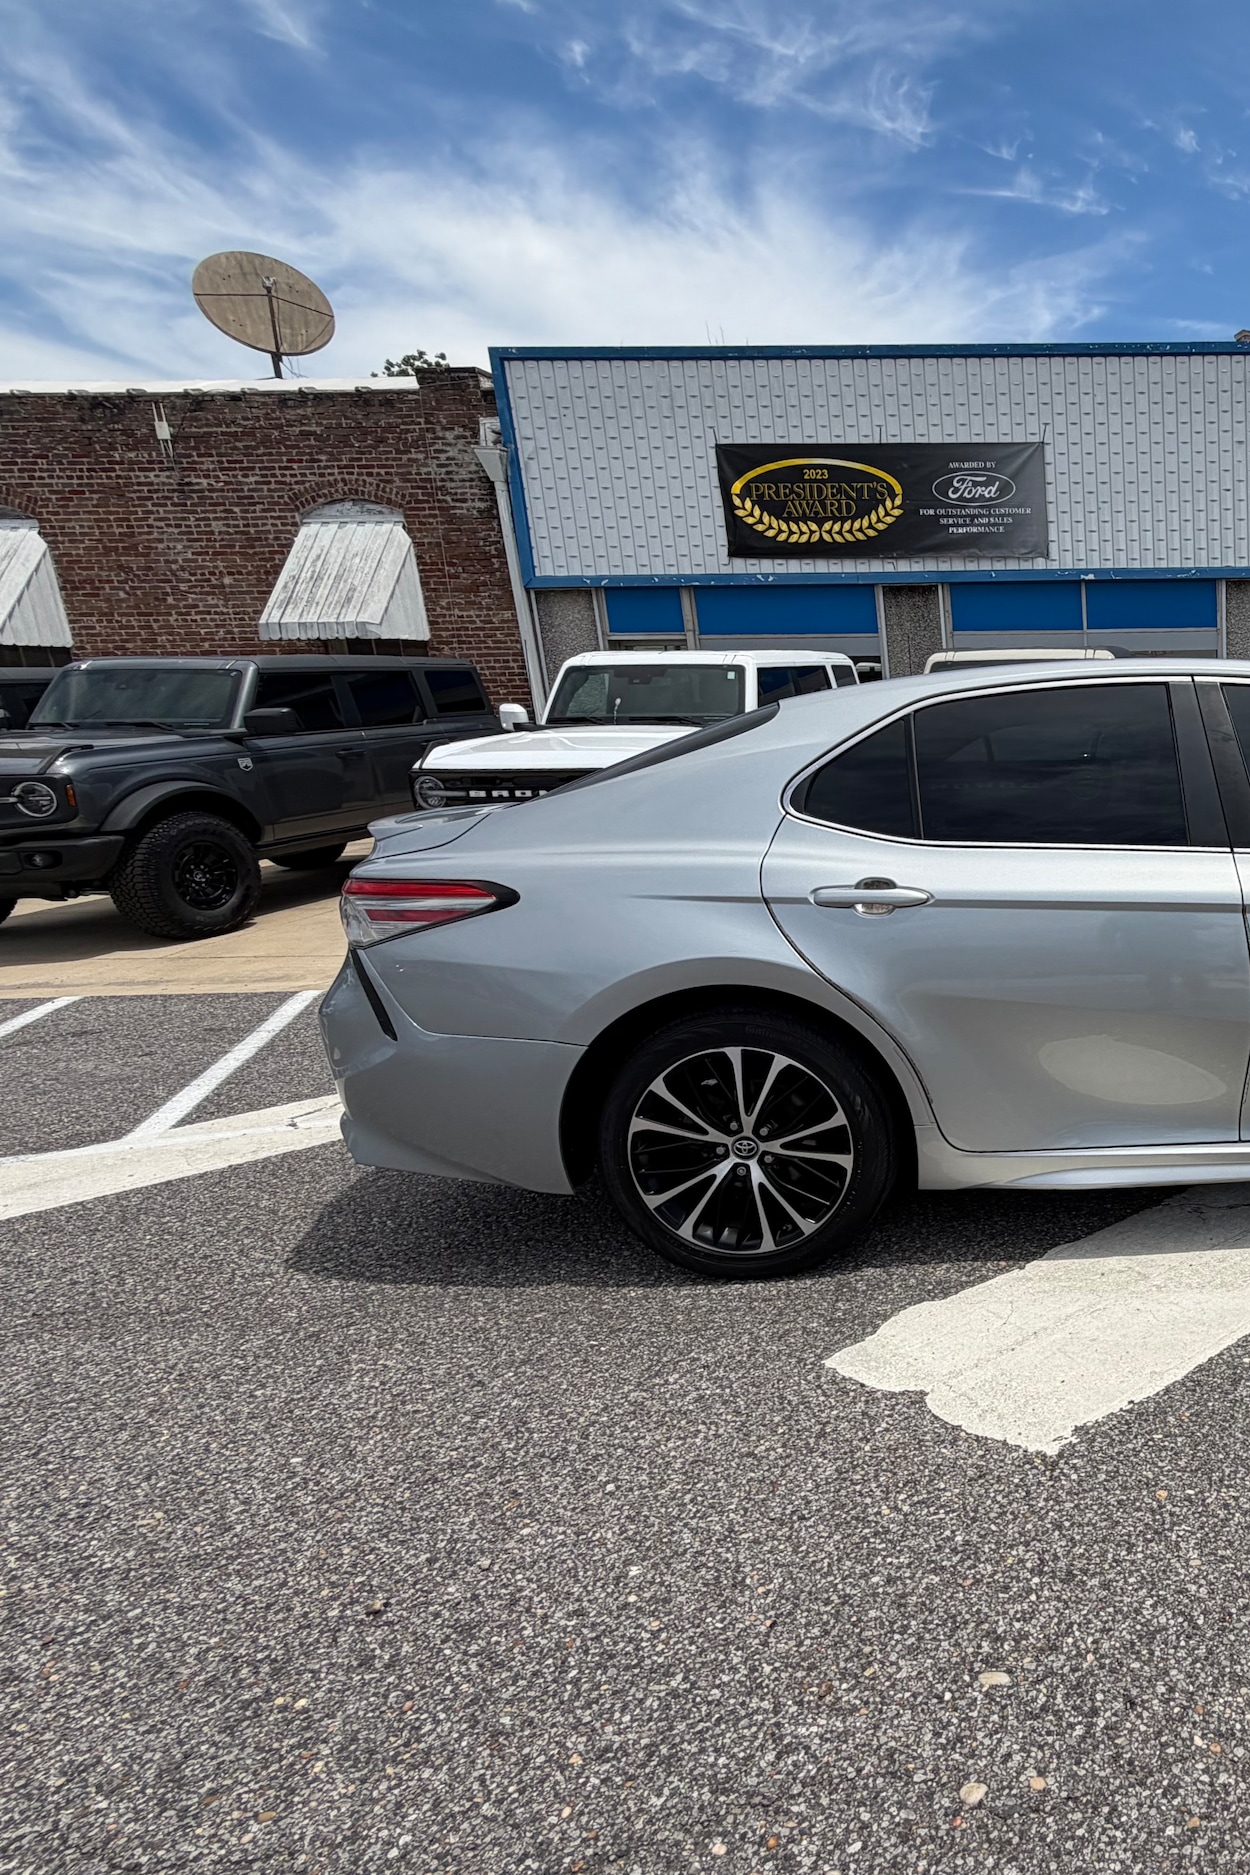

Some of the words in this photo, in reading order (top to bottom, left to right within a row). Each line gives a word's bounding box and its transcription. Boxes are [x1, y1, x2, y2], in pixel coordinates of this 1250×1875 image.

[948, 461, 985, 469] AWARDED
[803, 469, 829, 479] 2023
[749, 481, 889, 501] PRESIDENT'S
[948, 475, 1000, 499] Ford
[782, 499, 857, 517] AWARD
[919, 508, 935, 516] FOR
[936, 508, 990, 516] OUTSTANDING
[990, 507, 1032, 515] CUSTOMER
[939, 517, 971, 525] SERVICE
[989, 516, 1013, 524] SALES
[948, 525, 1006, 534] PERFORMANCE
